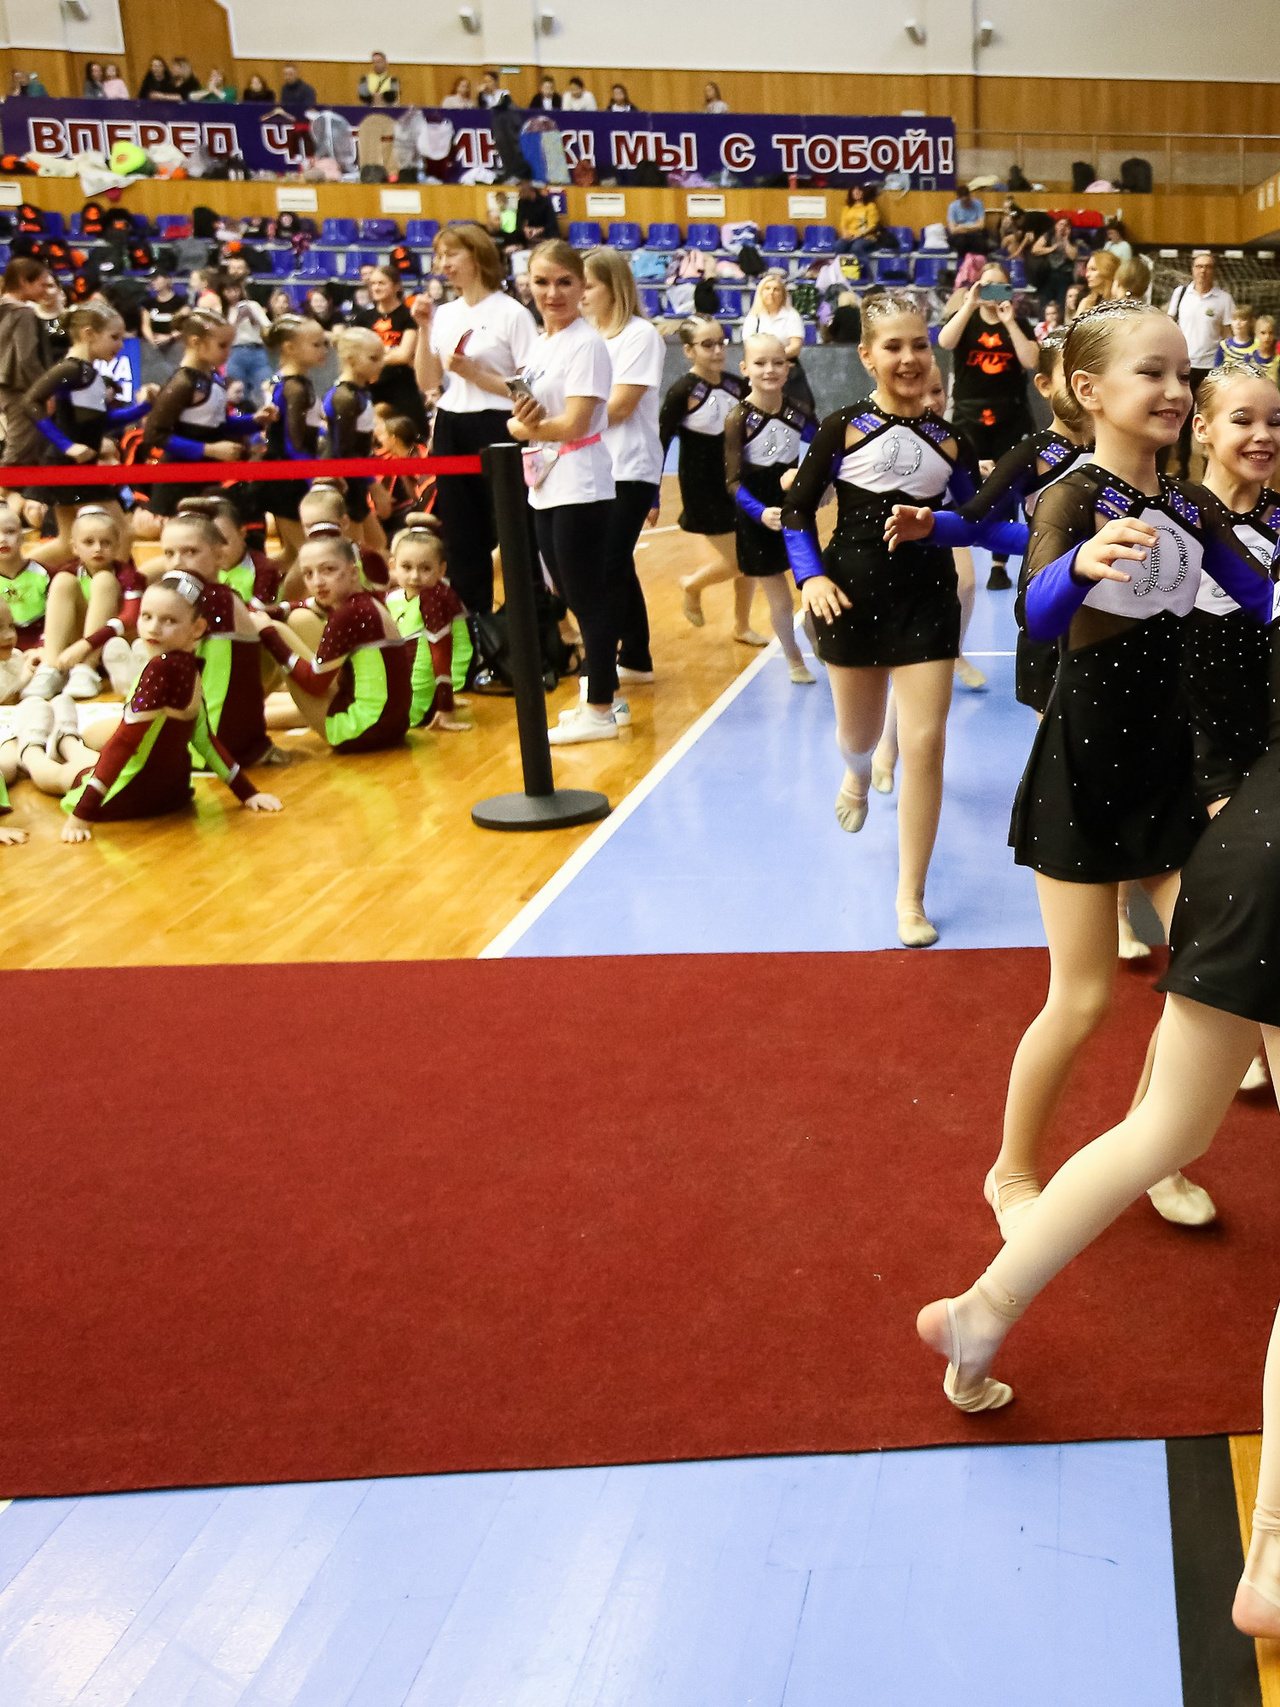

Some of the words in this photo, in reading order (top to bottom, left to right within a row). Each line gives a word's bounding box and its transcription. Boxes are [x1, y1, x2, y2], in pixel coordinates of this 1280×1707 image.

[610, 130, 698, 172] МЫ
[720, 133, 757, 173] С
[771, 128, 954, 175] ТОБОЙ!
